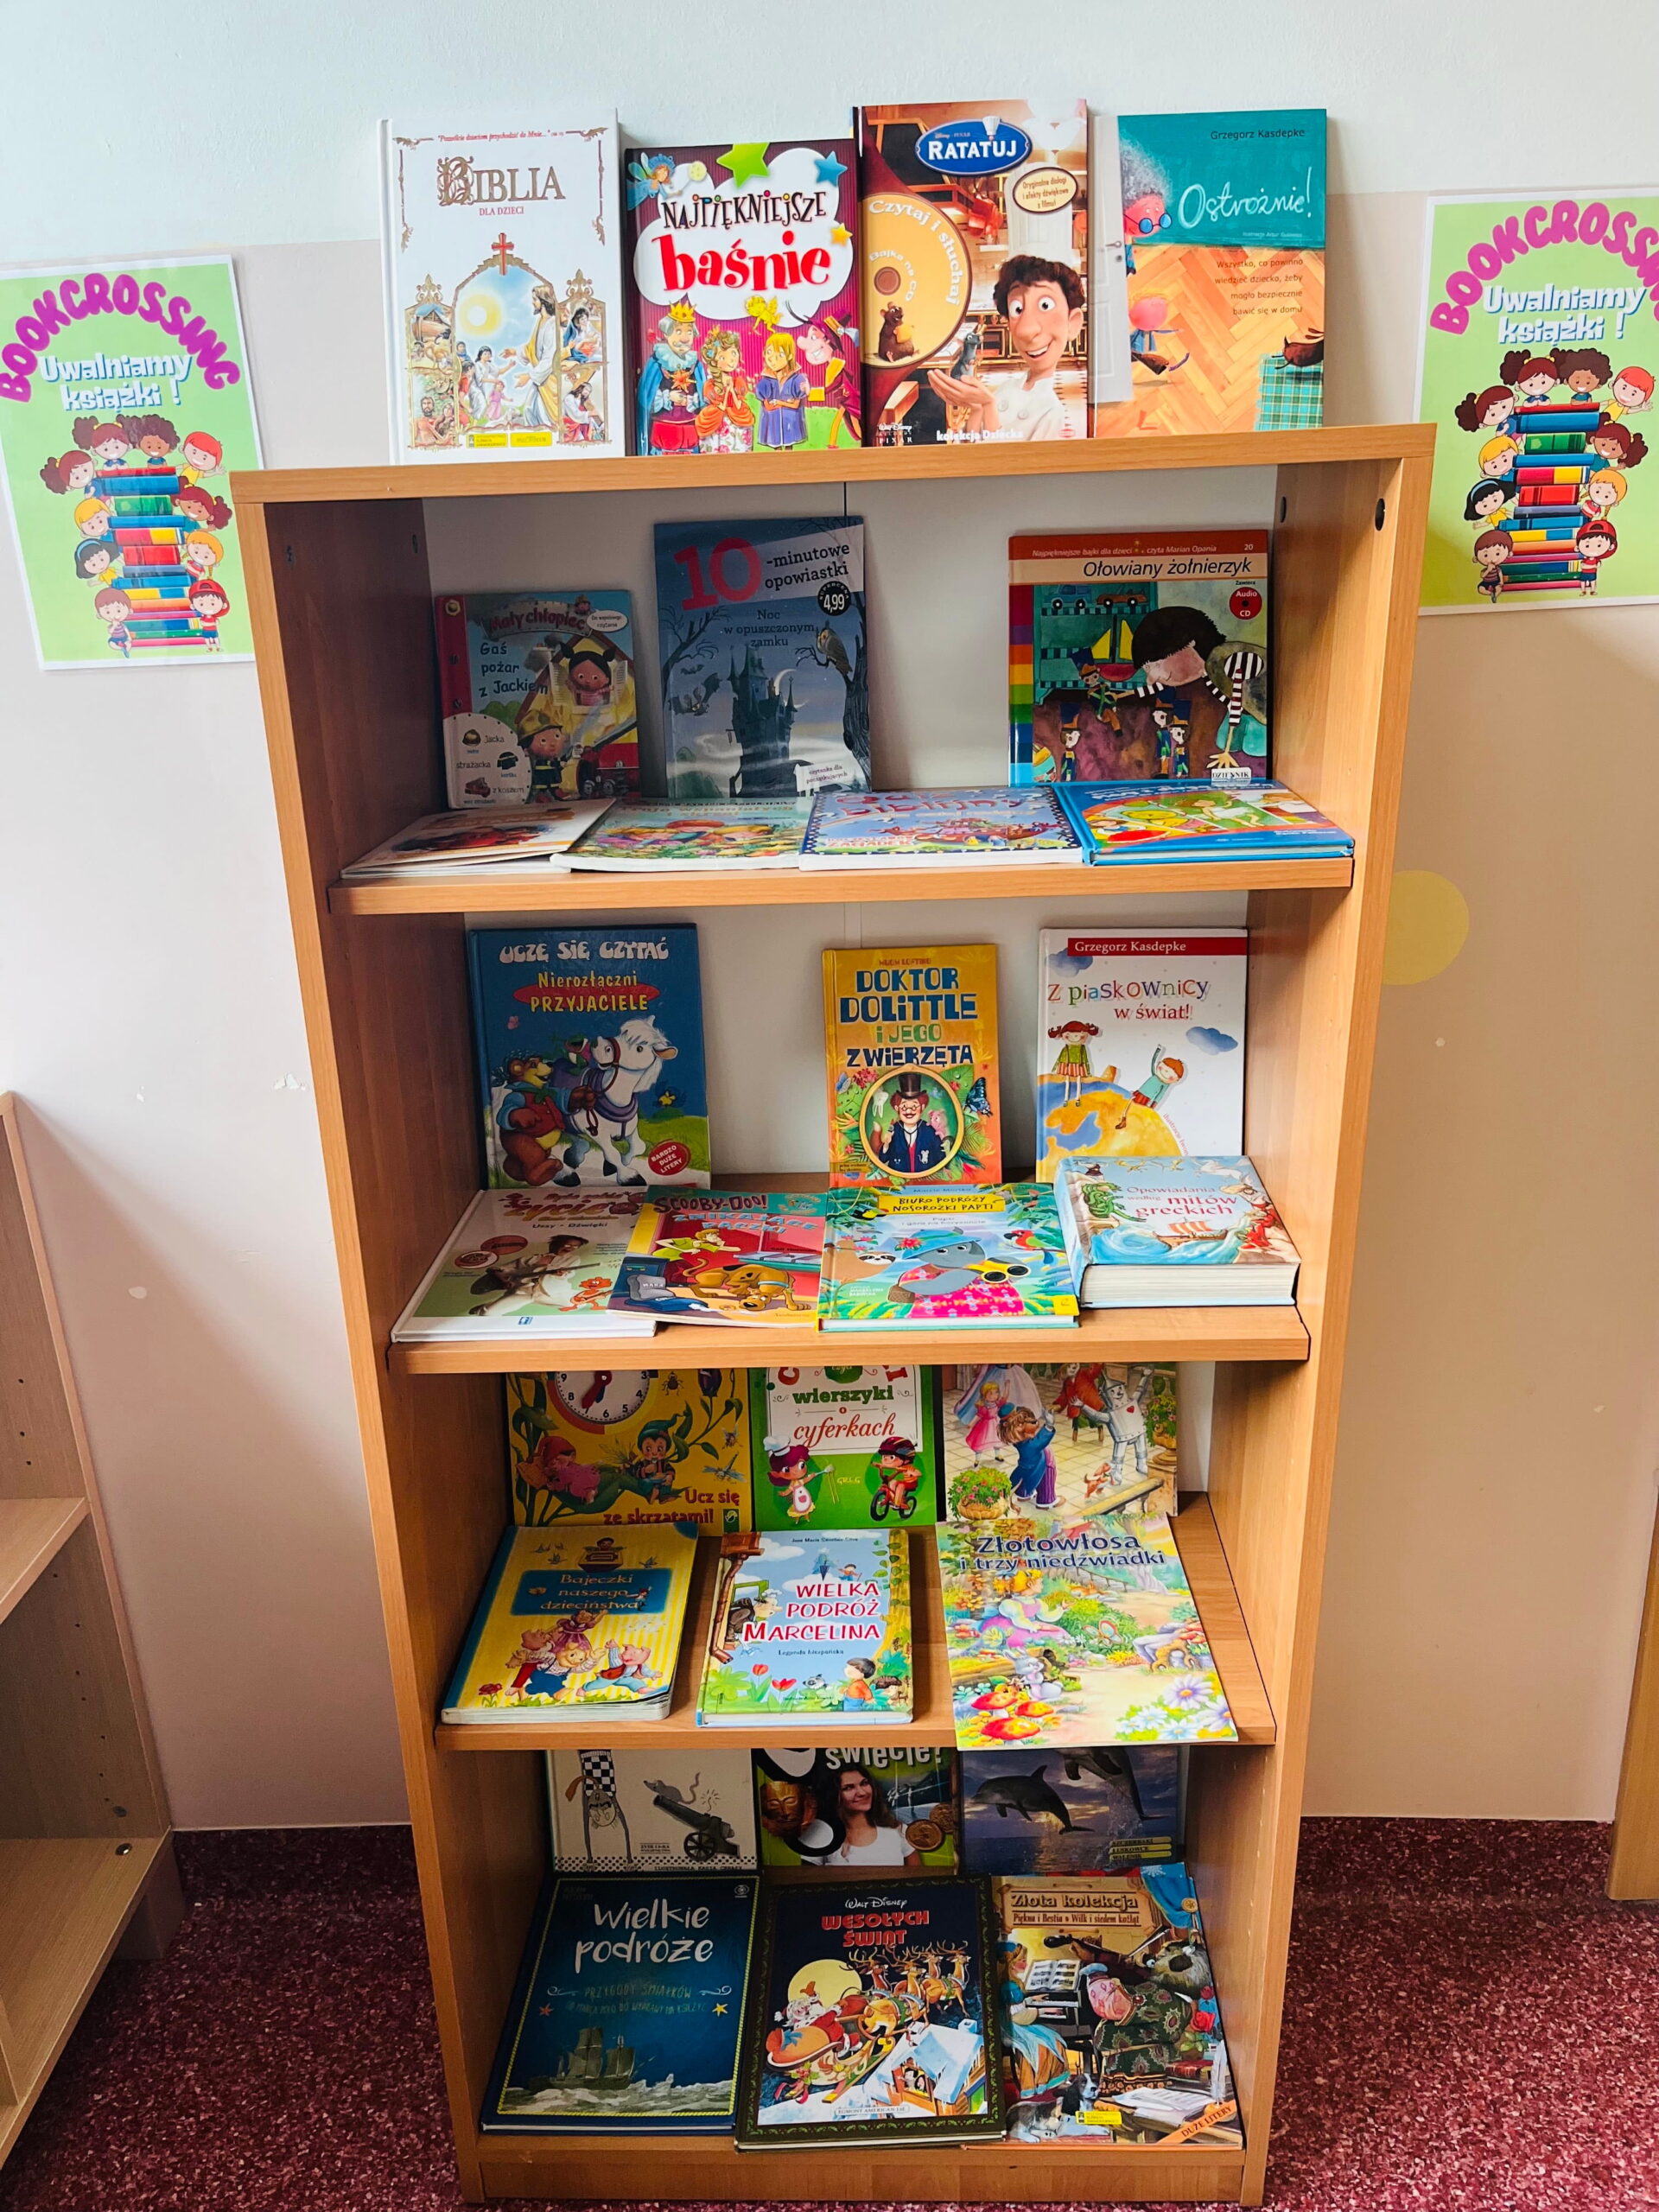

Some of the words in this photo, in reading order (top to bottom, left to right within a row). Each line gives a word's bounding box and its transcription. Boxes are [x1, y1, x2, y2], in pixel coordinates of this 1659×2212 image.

[1211, 130, 1255, 141] Grzegorz
[1257, 129, 1306, 139] Kasdepke
[928, 140, 1017, 161] RATATUJ
[436, 156, 567, 207] BIBLIA
[1178, 166, 1313, 230] Ostrożnie!
[480, 207, 496, 216] DLA
[497, 207, 524, 216] DZIECI
[869, 200, 931, 226] Czytaj
[652, 230, 831, 291] baśnie
[1217, 259, 1256, 269] Wszystko,
[1270, 258, 1303, 269] powinno
[1214, 276, 1249, 284] wiedzieć
[1250, 275, 1281, 284] dziecko,
[1284, 274, 1303, 283] żeby
[1257, 289, 1303, 300] bezpiecznie
[1483, 283, 1648, 315] Uwalniamy
[1233, 307, 1256, 315] bawić
[1257, 307, 1269, 316] się
[1498, 313, 1605, 346] książki
[38, 353, 193, 383] Uwalniamy
[60, 382, 162, 412] książki
[1083, 548, 1099, 556] bajki
[1113, 546, 1133, 555] dzieci
[1147, 546, 1165, 556] czyta
[1166, 545, 1191, 554] Marian
[1192, 545, 1217, 555] Opania
[674, 537, 763, 611] 10
[766, 544, 850, 569] -minutowe
[765, 562, 849, 591] opowiastki
[1084, 560, 1163, 580] Ołowiany
[1166, 557, 1251, 576] żołnierzyk
[823, 593, 845, 614] 4,99
[525, 607, 586, 631] chłopiec
[757, 609, 781, 620] Noc
[736, 624, 816, 636] opuszczonym
[480, 642, 507, 656] Gaś
[750, 636, 789, 647] zamku
[481, 662, 520, 677] pożar
[478, 686, 488, 698] z
[493, 678, 548, 696] Jackiem
[840, 798, 1026, 816] biblijny
[599, 937, 670, 961] CZYTAĆ
[1074, 942, 1127, 954] Grzegorz
[1130, 941, 1186, 954] Kasdepke
[537, 970, 638, 990] Nierozłączni
[856, 968, 959, 993] DOKTOR
[1047, 983, 1062, 1002] Z
[531, 995, 648, 1013] PRZYJACIELE
[1115, 1007, 1130, 1020] w
[1135, 1004, 1192, 1020] świat!
[888, 1024, 942, 1043] JEGO
[847, 1045, 974, 1067] ZWIERZĘTA
[651, 1145, 677, 1162] BARDZO
[658, 1153, 677, 1166] DUŻE
[660, 1157, 683, 1173] LITERY
[937, 1195, 987, 1204] PODRÓŻY
[1127, 1186, 1217, 1196] Opowiadania
[1167, 1195, 1238, 1205] mitów
[893, 1204, 957, 1212] NOSOROŻKI
[1134, 1205, 1233, 1217] greckich
[568, 1392, 575, 1401] 8
[635, 1389, 643, 1398] 4
[792, 1385, 894, 1405] wierszyki
[602, 1408, 610, 1418] 6
[621, 1404, 629, 1413] 5
[793, 1412, 897, 1448] cyferkach
[684, 1489, 716, 1505] Ucz
[719, 1489, 740, 1507] się
[603, 1512, 622, 1525] ze
[627, 1508, 715, 1525] skrzatami!
[976, 1532, 1141, 1555] Złotowłosa
[959, 1557, 967, 1571] i
[974, 1556, 1020, 1573] trzy
[1027, 1551, 1166, 1570] niedźwiadki
[560, 1573, 633, 1586] Bajeczki
[557, 1588, 630, 1599] naszego
[797, 1582, 880, 1599] WIELKA
[540, 1599, 639, 1611] dzieciństwa
[786, 1599, 880, 1618] PODRÓŻ
[743, 1622, 880, 1642] MARCELINA
[1011, 1894, 1057, 1909] Złota
[1062, 1894, 1139, 1911] kolekcja
[594, 1898, 710, 1929] Wielkie
[822, 1910, 930, 1931] WESOŁYCH
[1013, 1913, 1036, 1924] Piękna
[1042, 1913, 1063, 1923] Bestia
[1071, 1914, 1087, 1923] Wilk
[1094, 1914, 1116, 1923] siedem
[575, 1930, 714, 1974] podróże
[1205, 2106, 1232, 2124] LITERY
